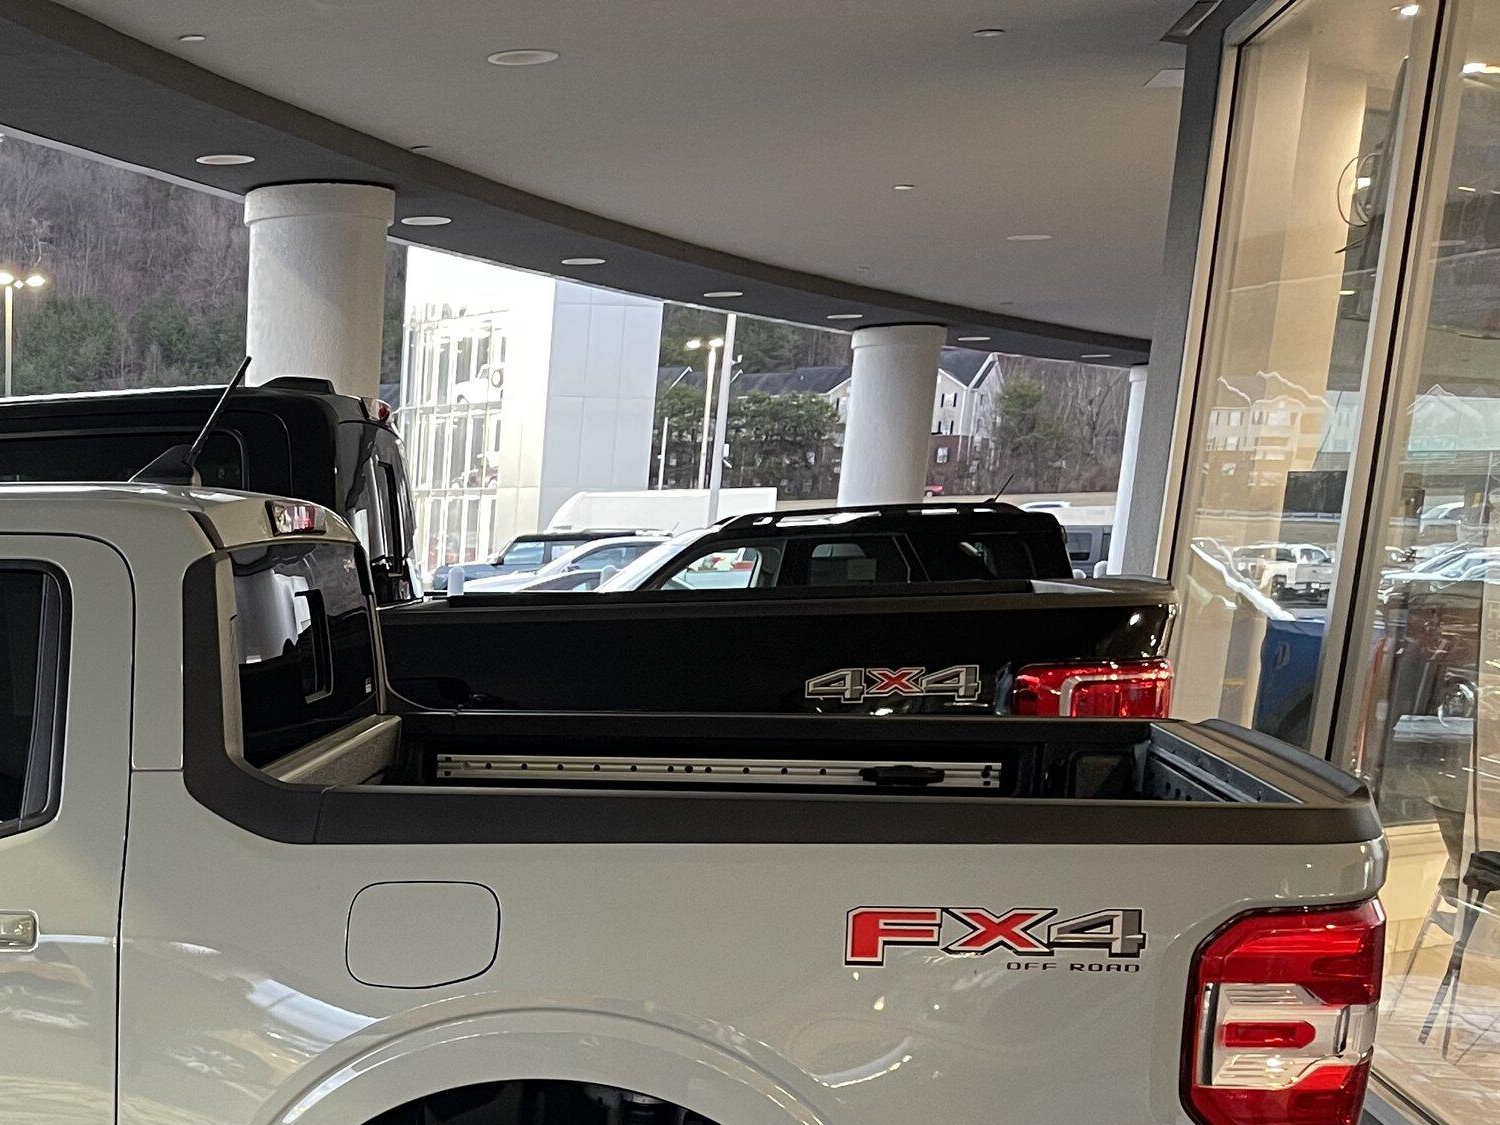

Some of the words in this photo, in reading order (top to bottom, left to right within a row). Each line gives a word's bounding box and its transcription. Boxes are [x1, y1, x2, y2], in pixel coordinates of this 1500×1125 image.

[845, 906, 1146, 967] FX4
[1006, 961, 1058, 972] OFF
[1069, 962, 1141, 974] ROAD
